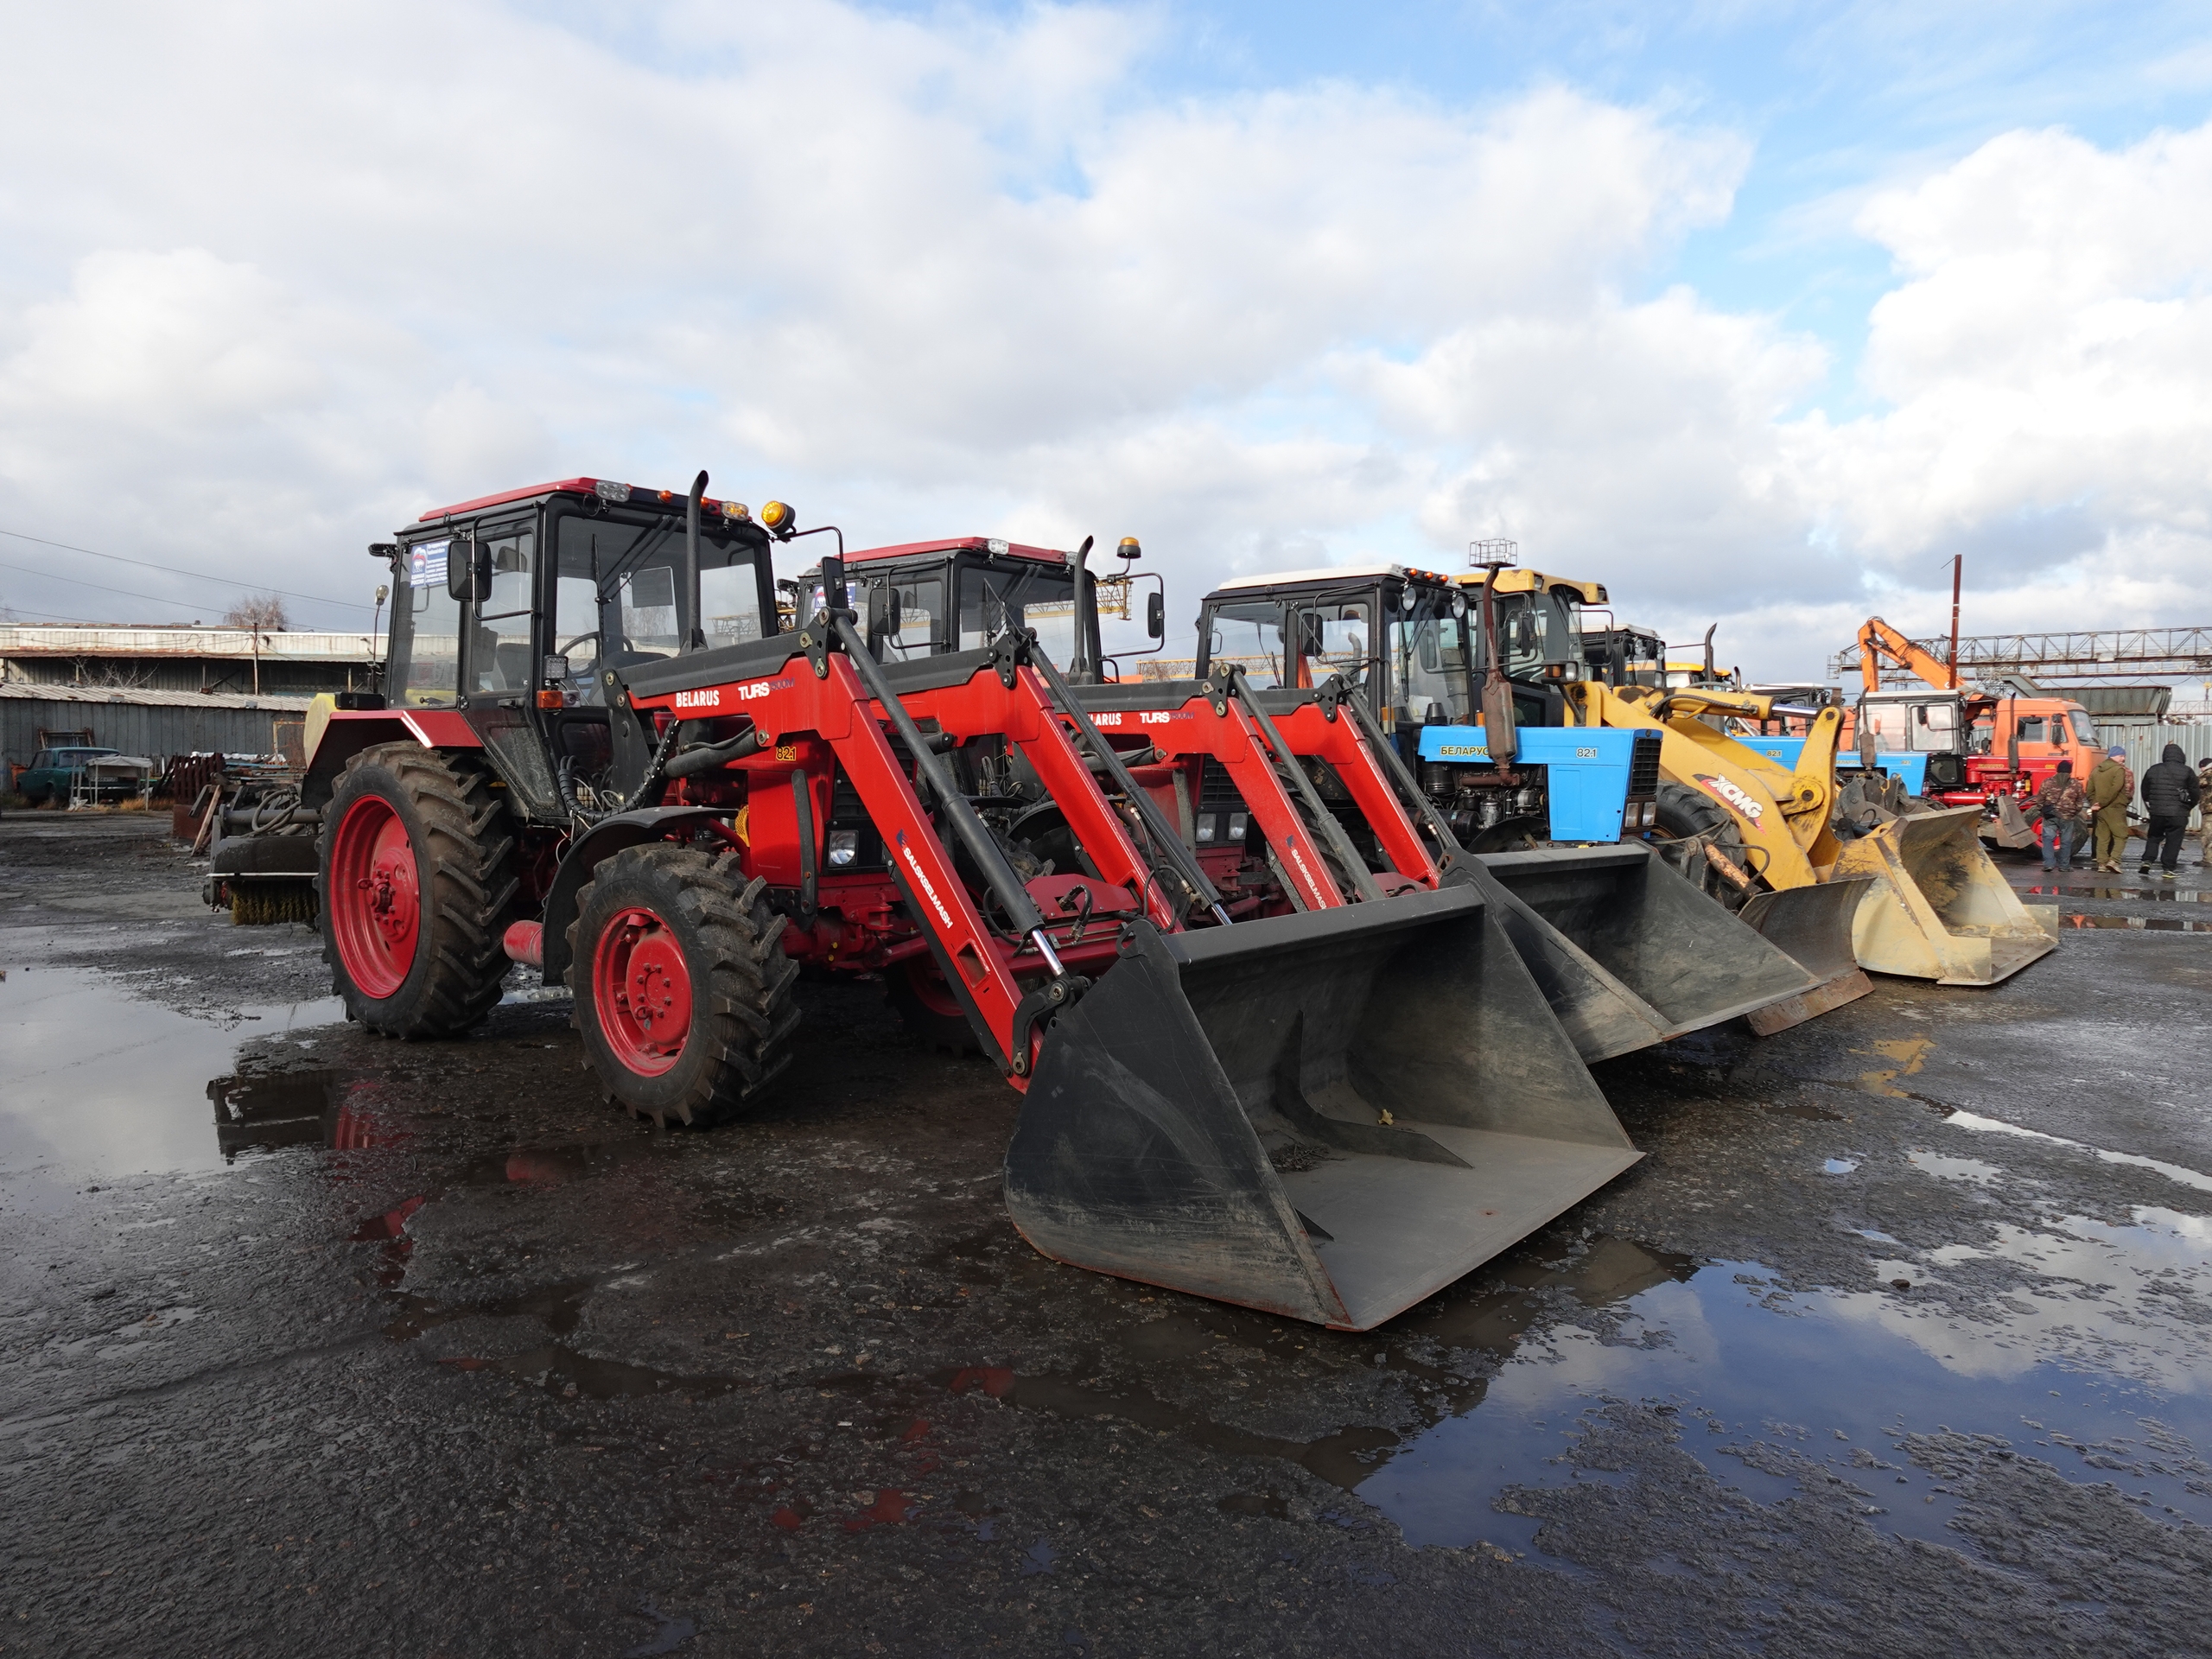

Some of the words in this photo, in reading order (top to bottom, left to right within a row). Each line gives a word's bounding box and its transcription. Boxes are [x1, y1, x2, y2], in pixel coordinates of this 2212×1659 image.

[676, 690, 720, 708] BELARUS
[738, 682, 770, 701] TURS
[1088, 712, 1122, 726] LARUS
[1140, 712, 1170, 724] TURS
[1576, 747, 1598, 758] 82.1
[1707, 772, 1764, 818] XCMG
[903, 847, 953, 929] SALSKSELMASH
